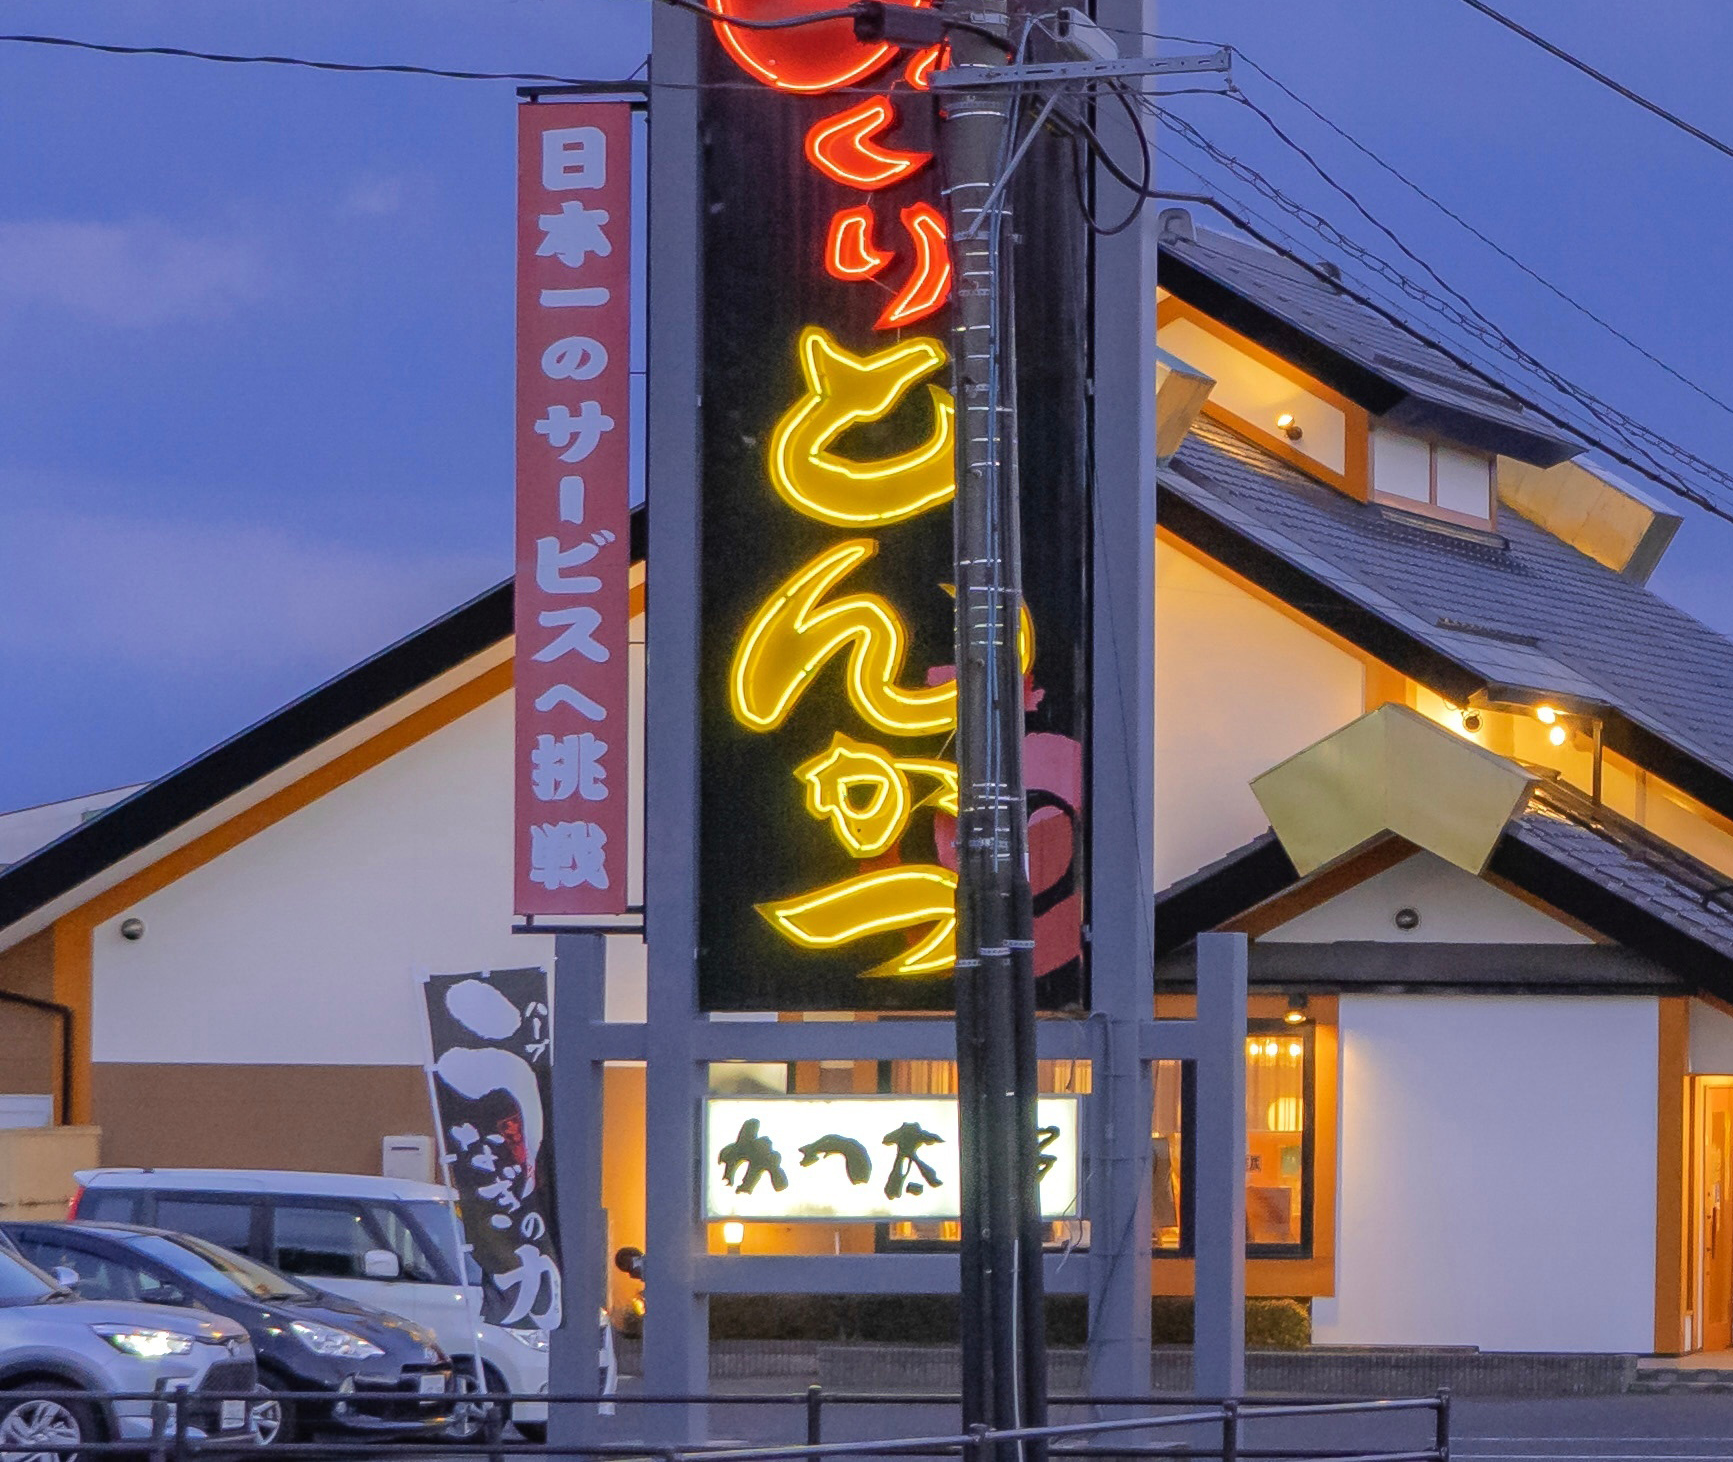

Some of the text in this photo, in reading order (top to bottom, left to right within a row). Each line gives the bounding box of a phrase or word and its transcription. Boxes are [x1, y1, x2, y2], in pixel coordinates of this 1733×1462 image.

[529, 126, 614, 891] 日本一のサービスへ挑戦
[717, 1117, 1061, 1201] かつ太
